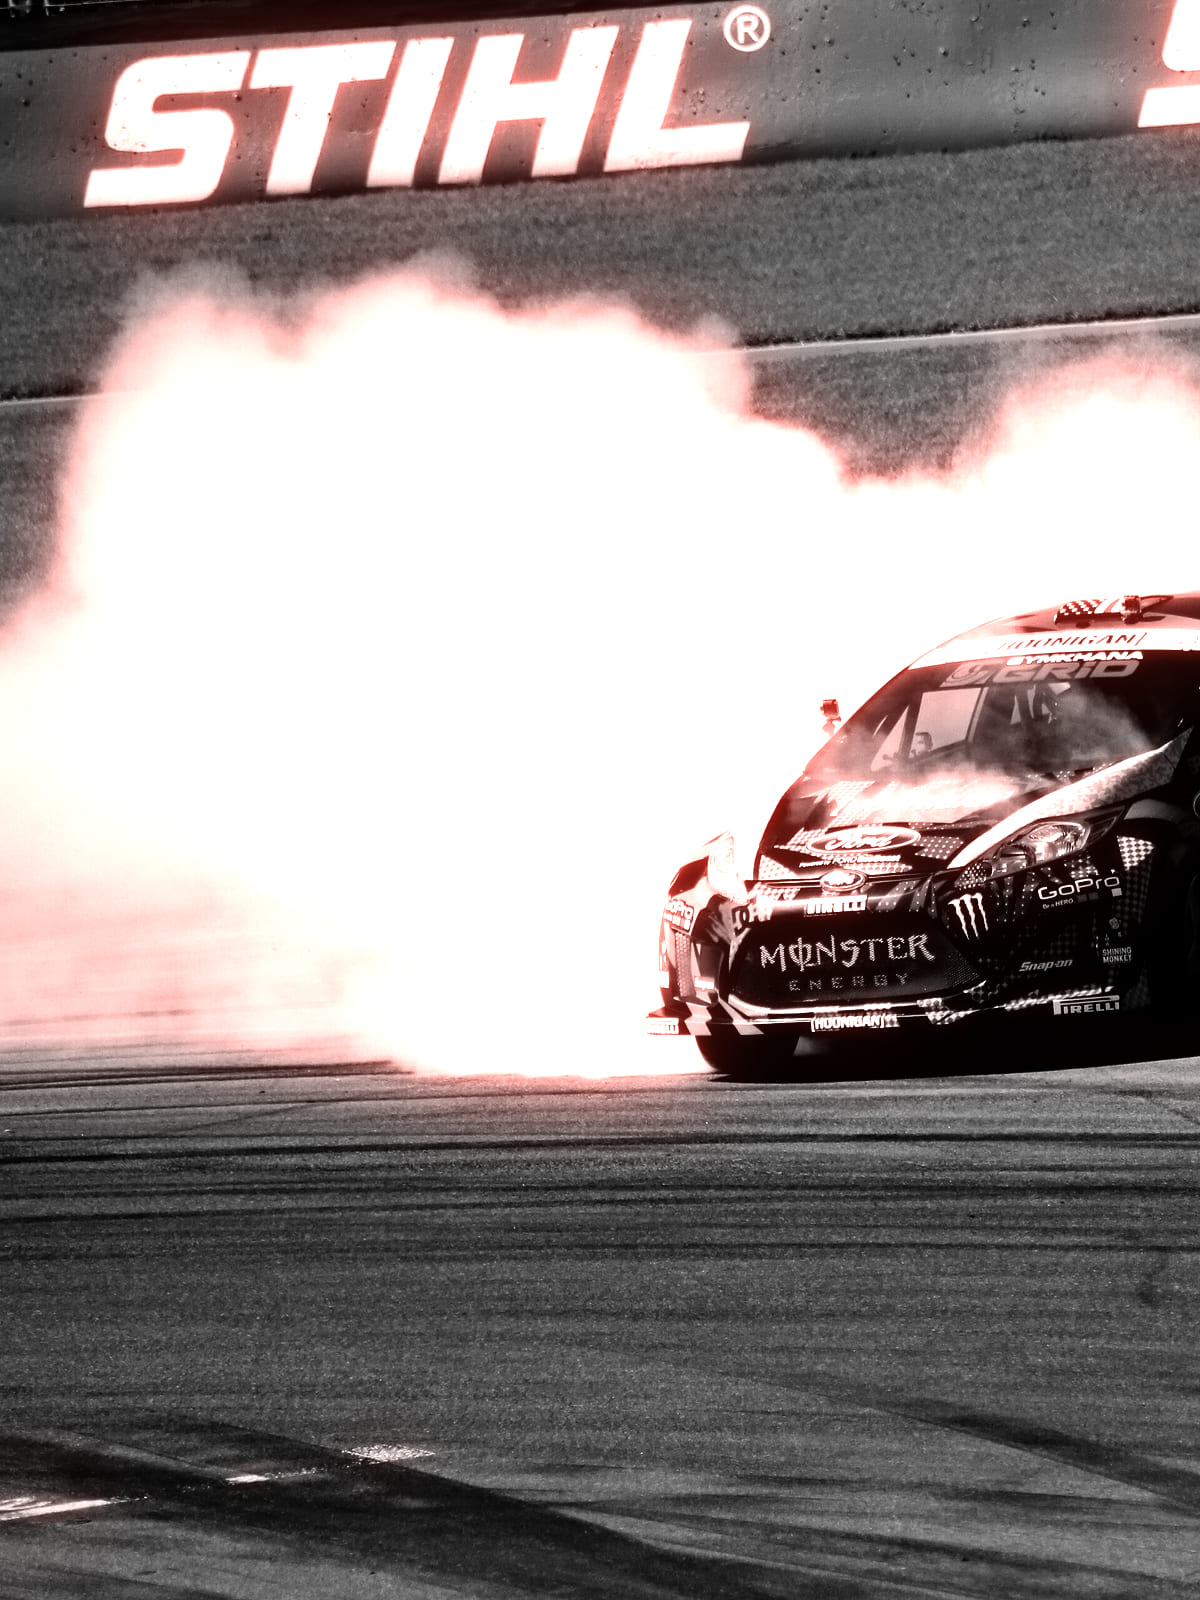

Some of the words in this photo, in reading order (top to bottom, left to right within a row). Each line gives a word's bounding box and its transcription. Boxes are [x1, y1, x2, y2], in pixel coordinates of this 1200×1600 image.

[83, 18, 751, 208] STIHL
[1006, 651, 1143, 666] GYMKHANA
[825, 829, 900, 850] Ford
[1038, 877, 1120, 900] GoPro
[806, 895, 868, 914] PIRELLI
[1055, 898, 1074, 907] HERO
[760, 934, 936, 972] MONSTER
[1102, 946, 1132, 957] SHINING
[1018, 959, 1073, 972] Snap-on
[788, 973, 909, 992] ENERGY
[1052, 995, 1120, 1016] PIRELLI
